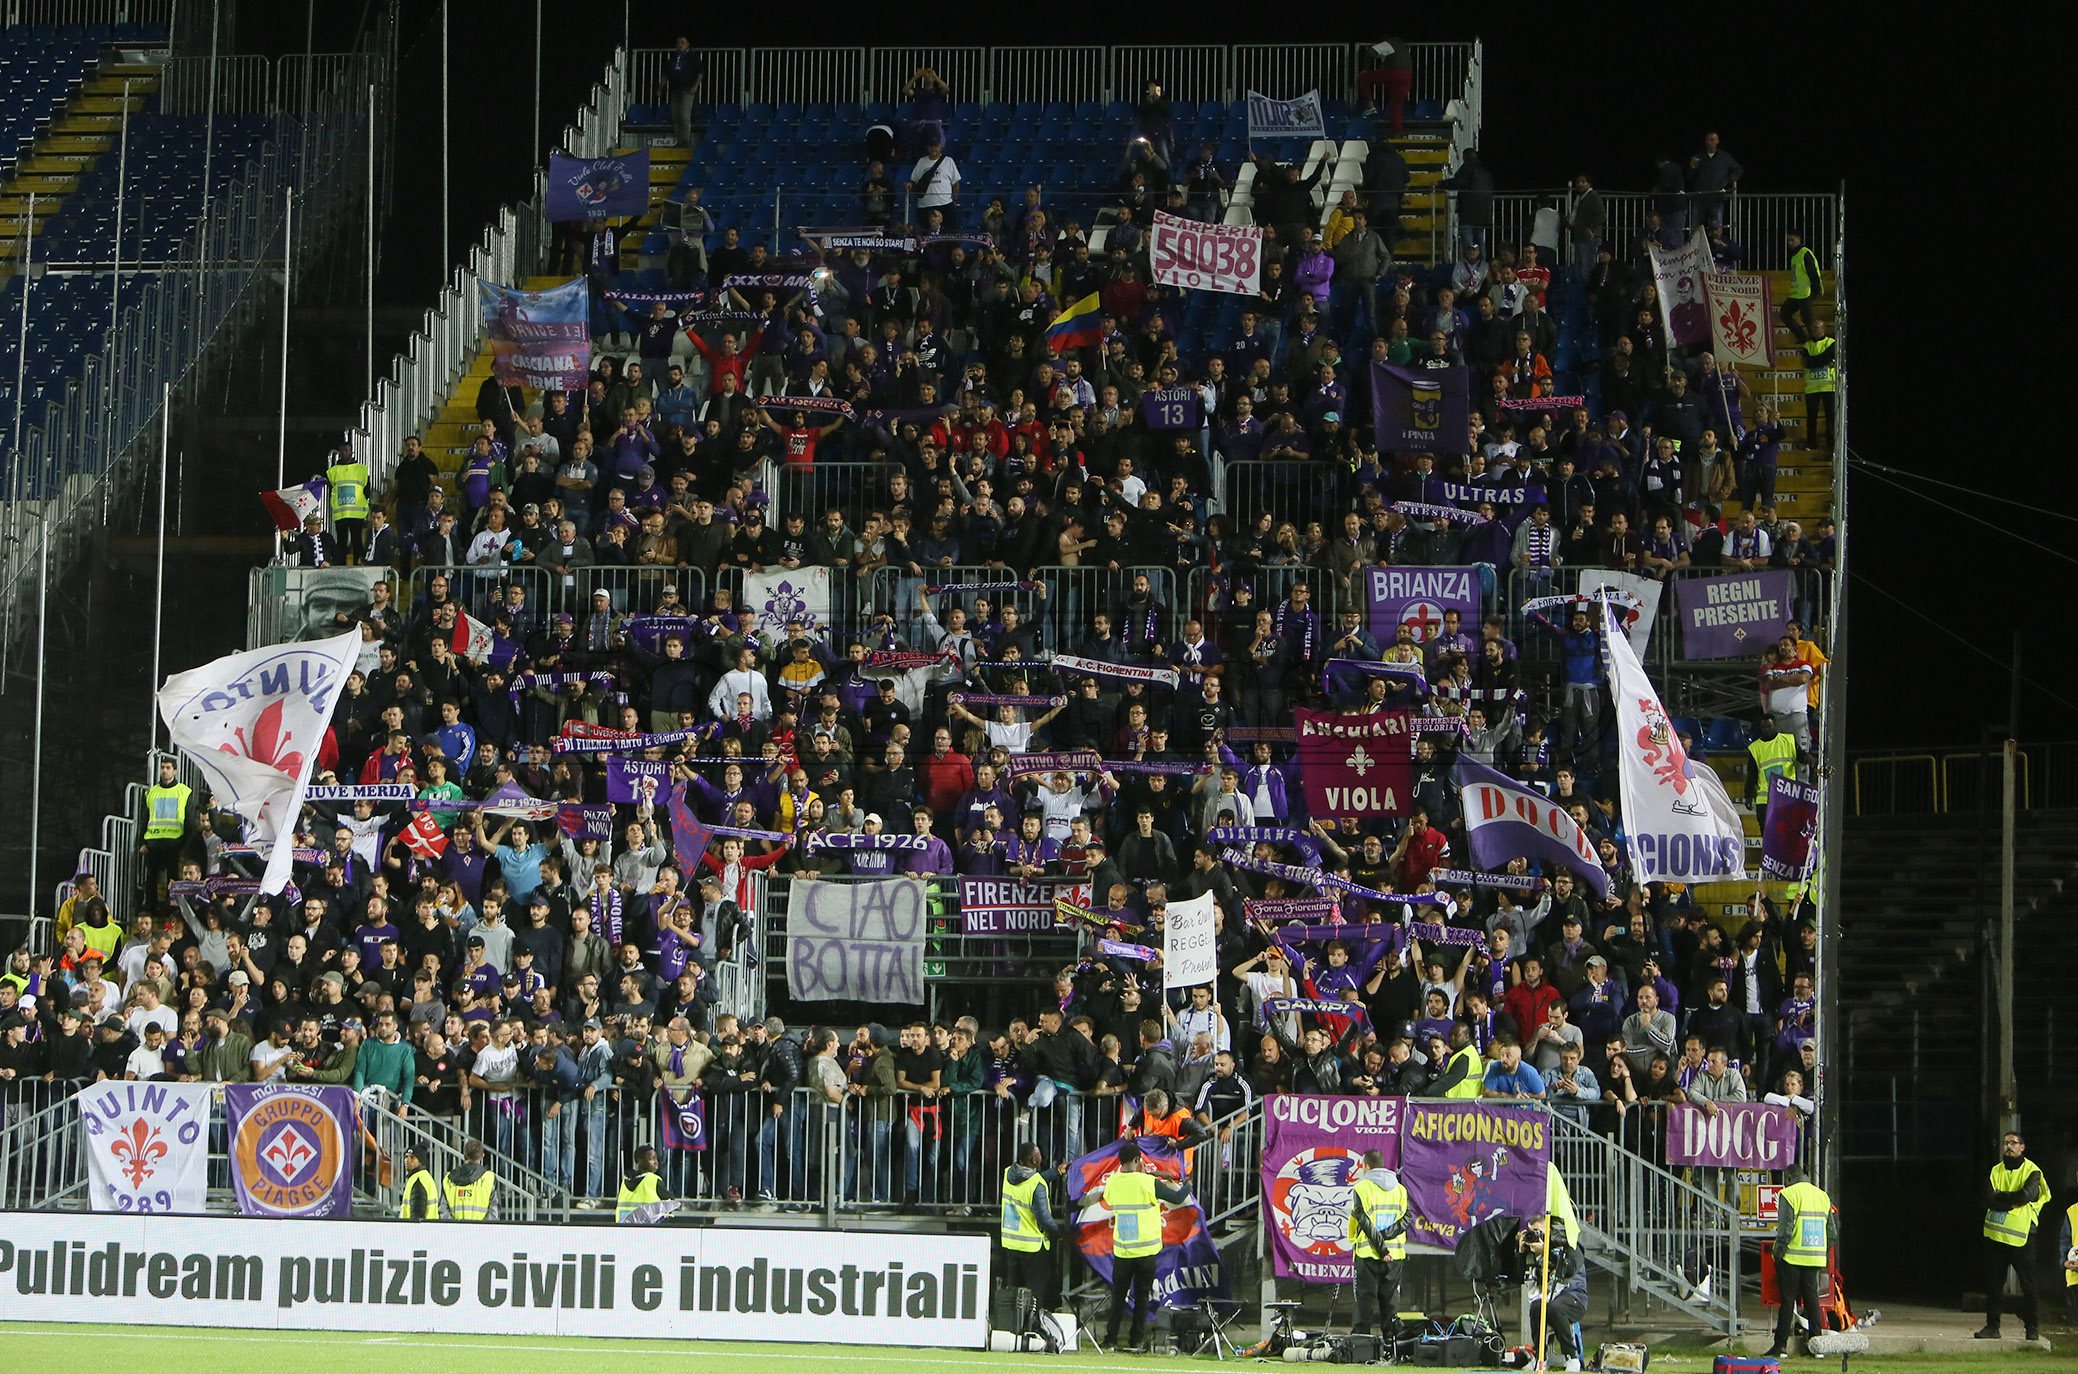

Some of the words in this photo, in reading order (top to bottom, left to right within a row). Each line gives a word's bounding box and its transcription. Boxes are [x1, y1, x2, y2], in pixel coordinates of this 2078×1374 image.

[592, 160, 612, 172] Club
[1153, 212, 1261, 239] SCARPERIA
[832, 237, 851, 247] SENZA
[853, 238, 861, 247] TE
[862, 238, 875, 247] NON
[875, 239, 884, 248] SO
[885, 239, 904, 248] STARE
[1156, 227, 1256, 279] 50038
[1154, 269, 1248, 293] VIOLA
[1707, 275, 1760, 285] FIRENZE
[1709, 284, 1728, 292] NEL
[1731, 286, 1760, 294] NORD
[695, 310, 758, 321] FIORENTINA
[1235, 340, 1246, 349] 20
[511, 353, 576, 372] CASCIANA
[526, 374, 564, 391] TERME
[1154, 389, 1191, 402] ASTORI
[1161, 404, 1185, 425] 13
[1407, 429, 1436, 440] PINTA
[1443, 482, 1526, 504] ULTRAS
[1399, 504, 1480, 526] PRESENTI
[1372, 571, 1471, 603] BRIANZA
[1706, 579, 1762, 605] REGNI
[1537, 596, 1568, 608] FORZA
[1692, 599, 1780, 628] PRESENTE
[1075, 659, 1096, 671] A.C.
[1096, 663, 1155, 678] FIORENTINA
[1423, 723, 1455, 732] GLORIA
[564, 738, 575, 751] DI
[576, 738, 614, 750] FIRENZE
[615, 736, 643, 750] VANTO
[622, 759, 667, 775] ASTORI
[305, 786, 349, 799] JUVE
[353, 784, 412, 798] MERDA
[1324, 786, 1398, 811] VIOLA
[1776, 778, 1801, 799] SAN
[1802, 787, 1819, 805] GO
[583, 809, 611, 823] PIAZZA
[806, 832, 866, 849] ACF
[874, 833, 928, 851] 1926
[1762, 854, 1794, 879] SENZA
[1504, 877, 1533, 888] VIOLA
[964, 881, 1053, 906] FIRENZE
[804, 880, 920, 941] CIAO
[1252, 903, 1284, 916] Forza
[1284, 901, 1332, 915] Fiorentina
[966, 910, 998, 931] NEL
[1005, 910, 1052, 930] NORD
[1170, 914, 1194, 930] Bar
[792, 935, 920, 1000] BOTTAI
[82, 1084, 200, 1145] QUINTO
[254, 1100, 325, 1128] GRUPPO
[1273, 1094, 1397, 1133] CICLONE
[1354, 1126, 1397, 1135] VIOLA
[1410, 1110, 1544, 1151] AFICIONADOS
[1683, 1108, 1781, 1162] DOCG
[250, 1175, 330, 1207] PIAGGE
[1414, 1216, 1456, 1237] Curva
[277, 1248, 462, 1308] pulizie
[477, 1252, 616, 1310] civili
[631, 1263, 663, 1311] e
[679, 1255, 978, 1320] industriali
